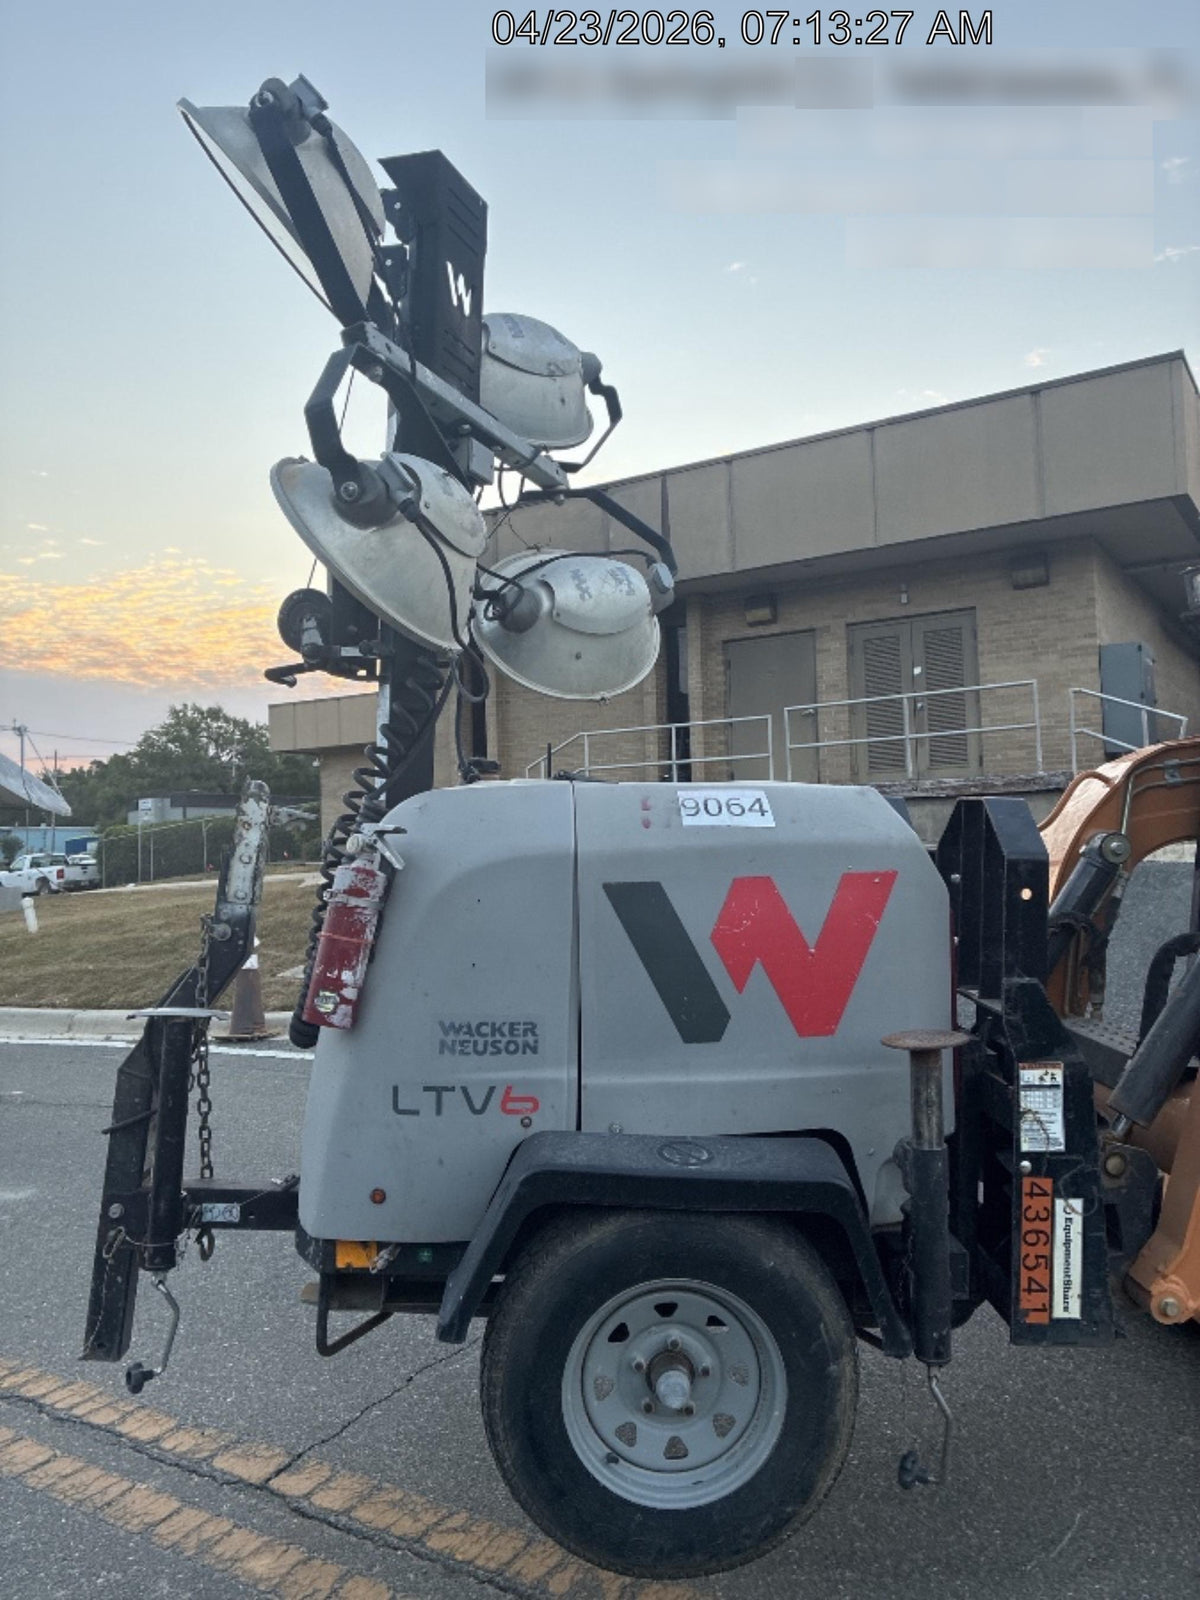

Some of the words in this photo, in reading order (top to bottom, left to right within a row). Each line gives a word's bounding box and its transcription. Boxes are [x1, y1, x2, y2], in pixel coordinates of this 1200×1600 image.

[681, 797, 768, 817] 9064
[439, 1020, 539, 1038] WACKER
[439, 1039, 539, 1056] NEUSON
[392, 1083, 540, 1116] LTV6
[1022, 1181, 1050, 1315] 436541
[1062, 1217, 1074, 1313] EquipmentShare
